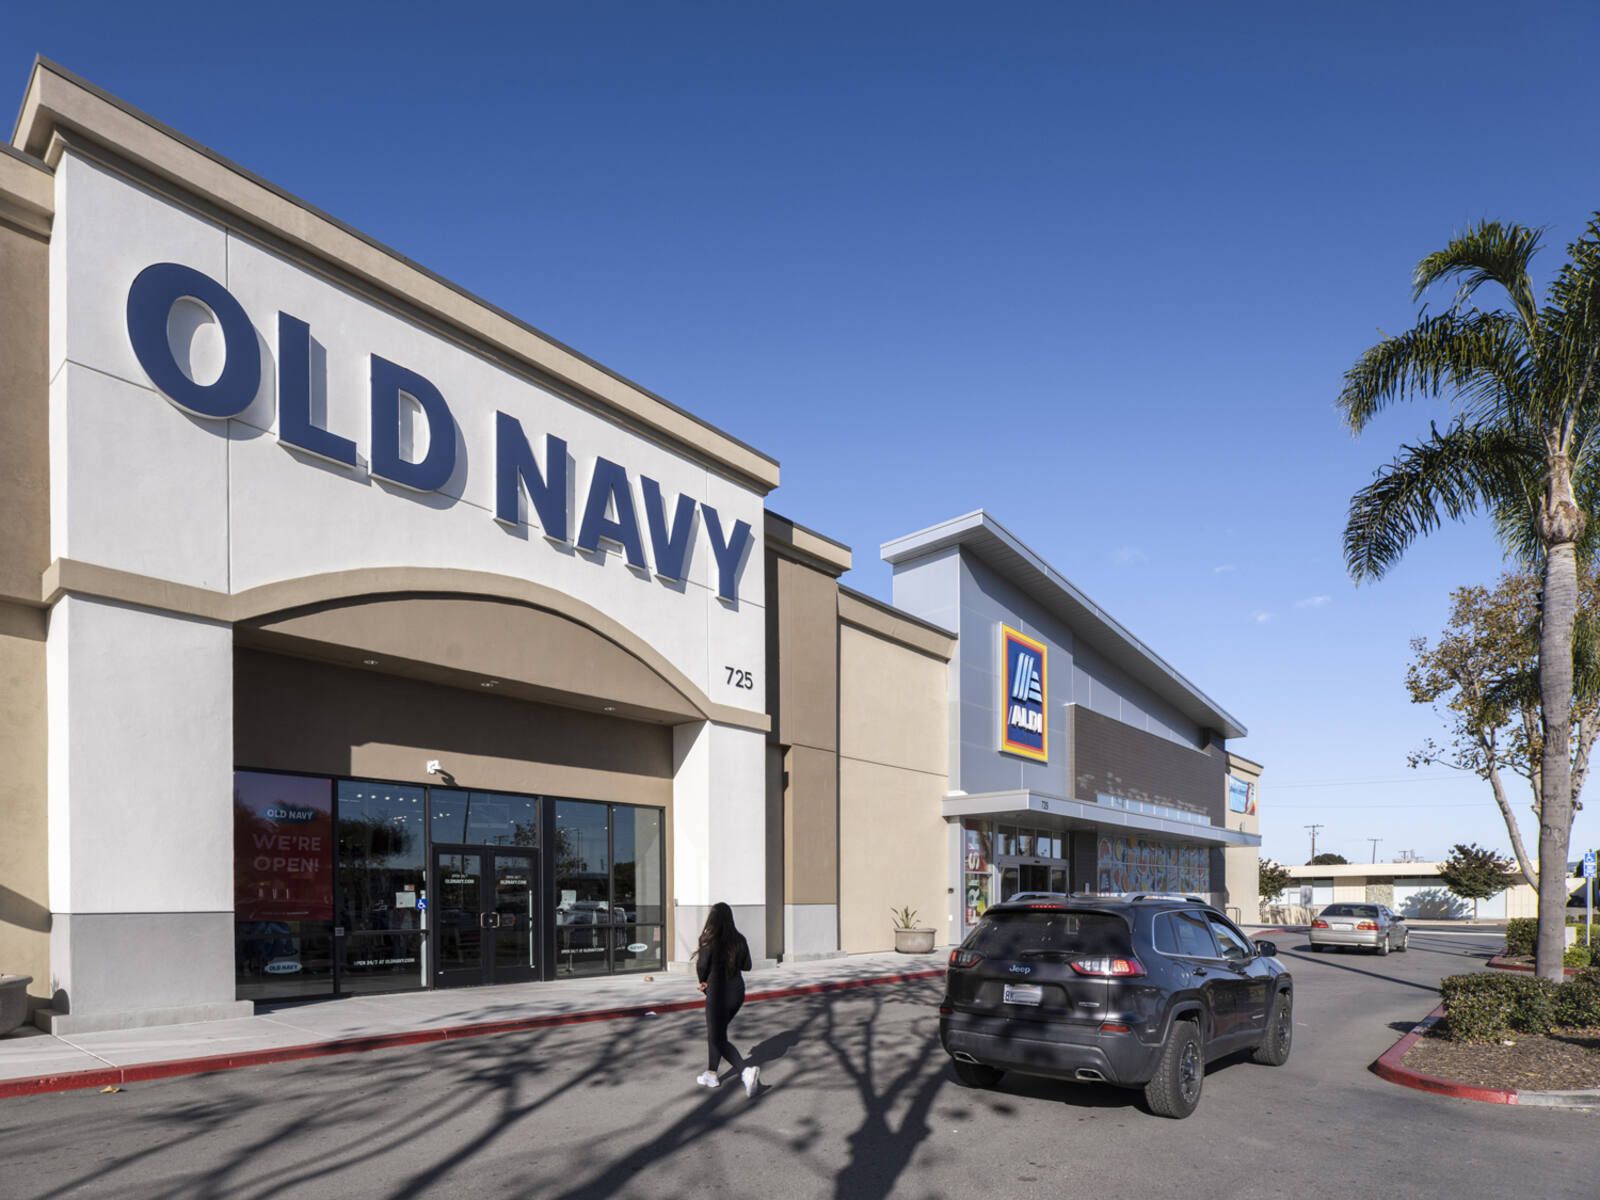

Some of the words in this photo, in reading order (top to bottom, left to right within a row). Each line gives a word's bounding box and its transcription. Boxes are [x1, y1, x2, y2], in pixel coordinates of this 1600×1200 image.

[126, 262, 456, 491] OLD
[493, 409, 752, 603] NAVY
[725, 666, 754, 690] 725
[1008, 704, 1042, 735] ALDI
[266, 808, 287, 818] OLD
[289, 811, 313, 820] NAVY
[252, 833, 321, 851] WE'RE
[253, 856, 320, 873] OPEN!
[1009, 964, 1031, 974] Jeep
